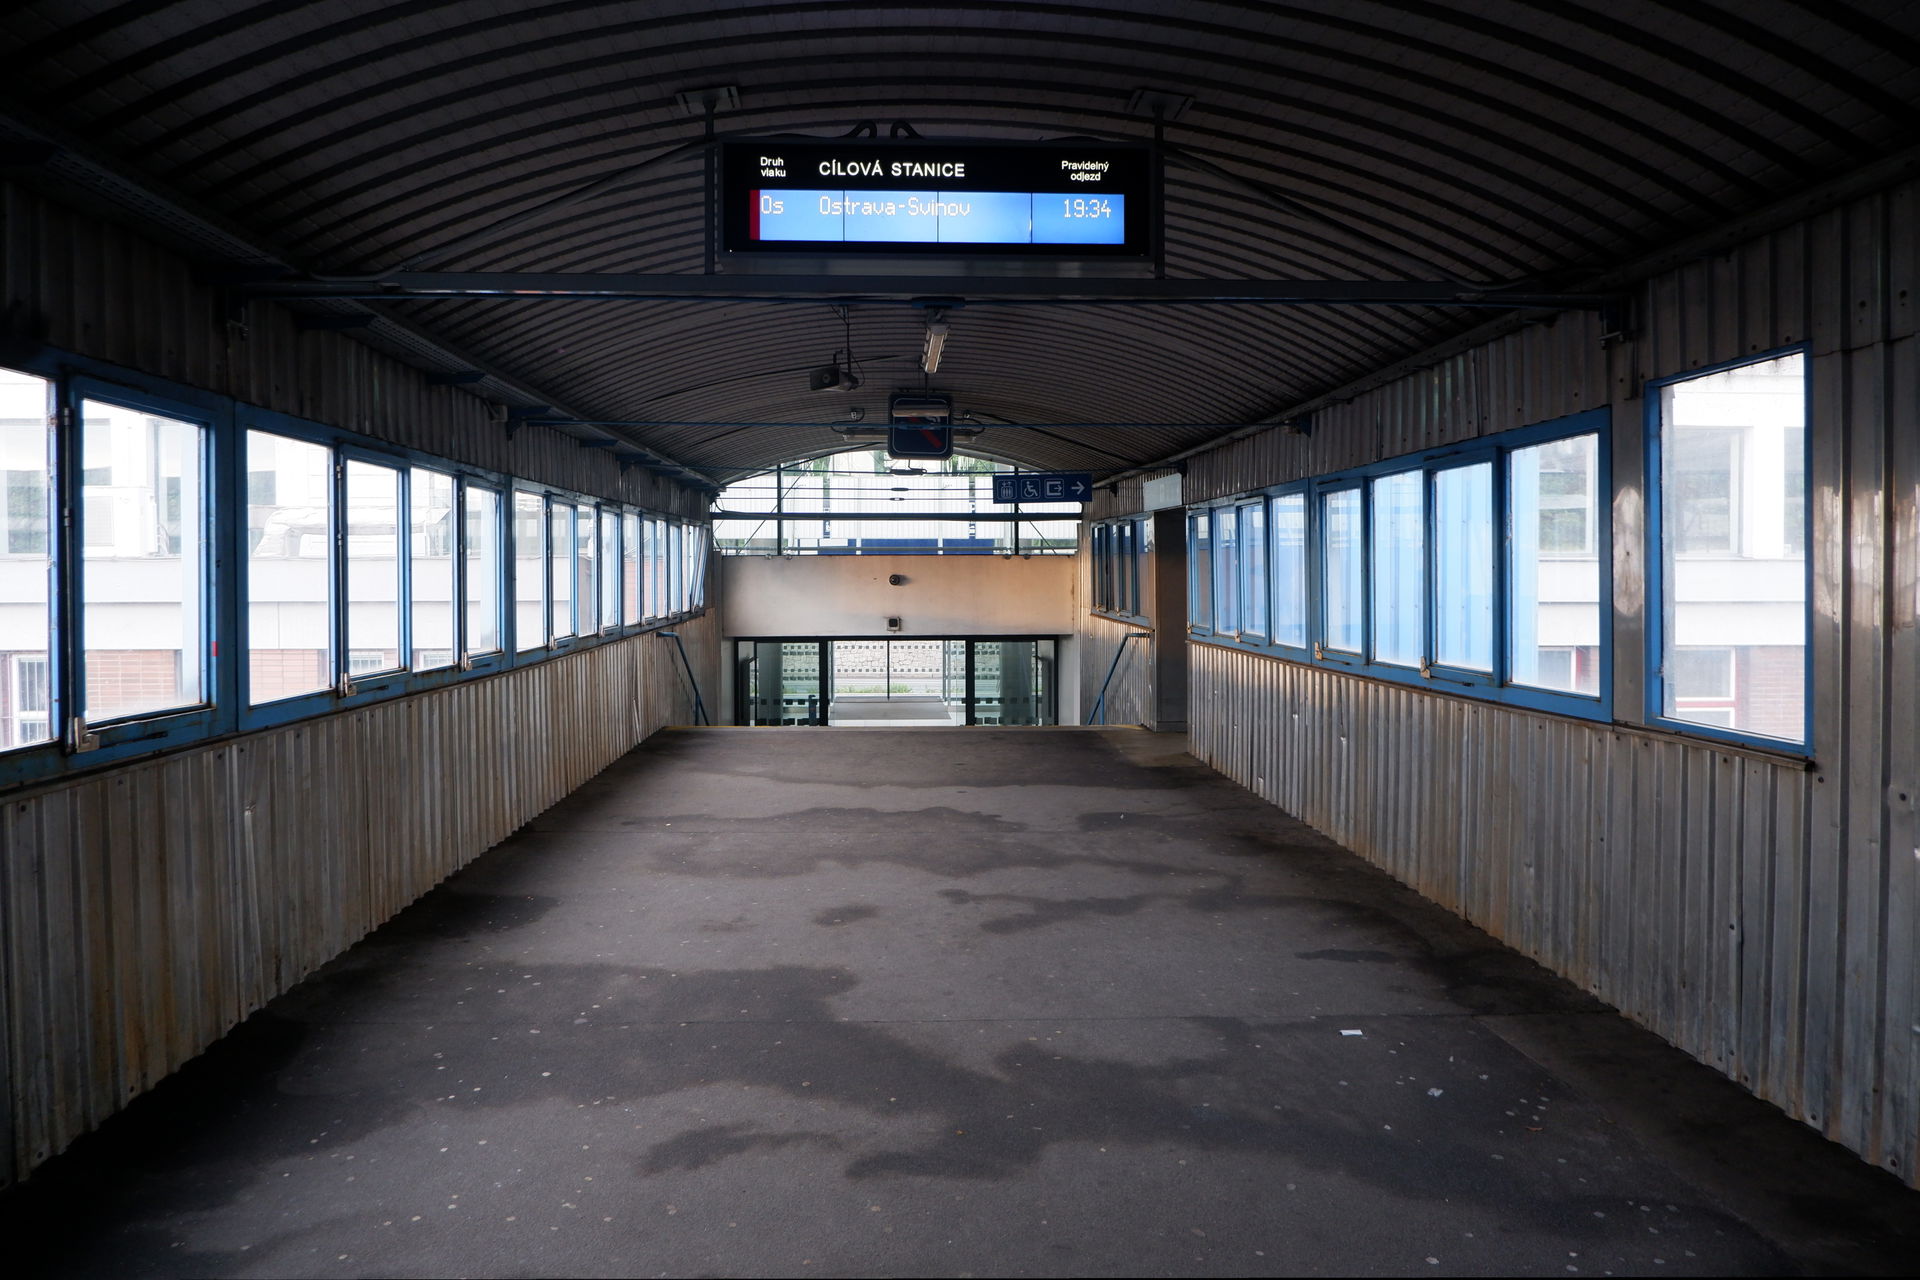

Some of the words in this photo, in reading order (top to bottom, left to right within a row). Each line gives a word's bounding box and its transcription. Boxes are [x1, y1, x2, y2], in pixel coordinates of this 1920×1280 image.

[760, 156, 784, 167] Druh
[1061, 161, 1110, 174] Pravidelný
[760, 168, 787, 178] vlaku
[818, 159, 883, 177] CÍLOVÁ
[890, 163, 965, 178] STANICE
[1070, 172, 1101, 183] odjezd
[818, 196, 971, 216] Ostrava-Svinov
[1063, 199, 1112, 218] 19:34
